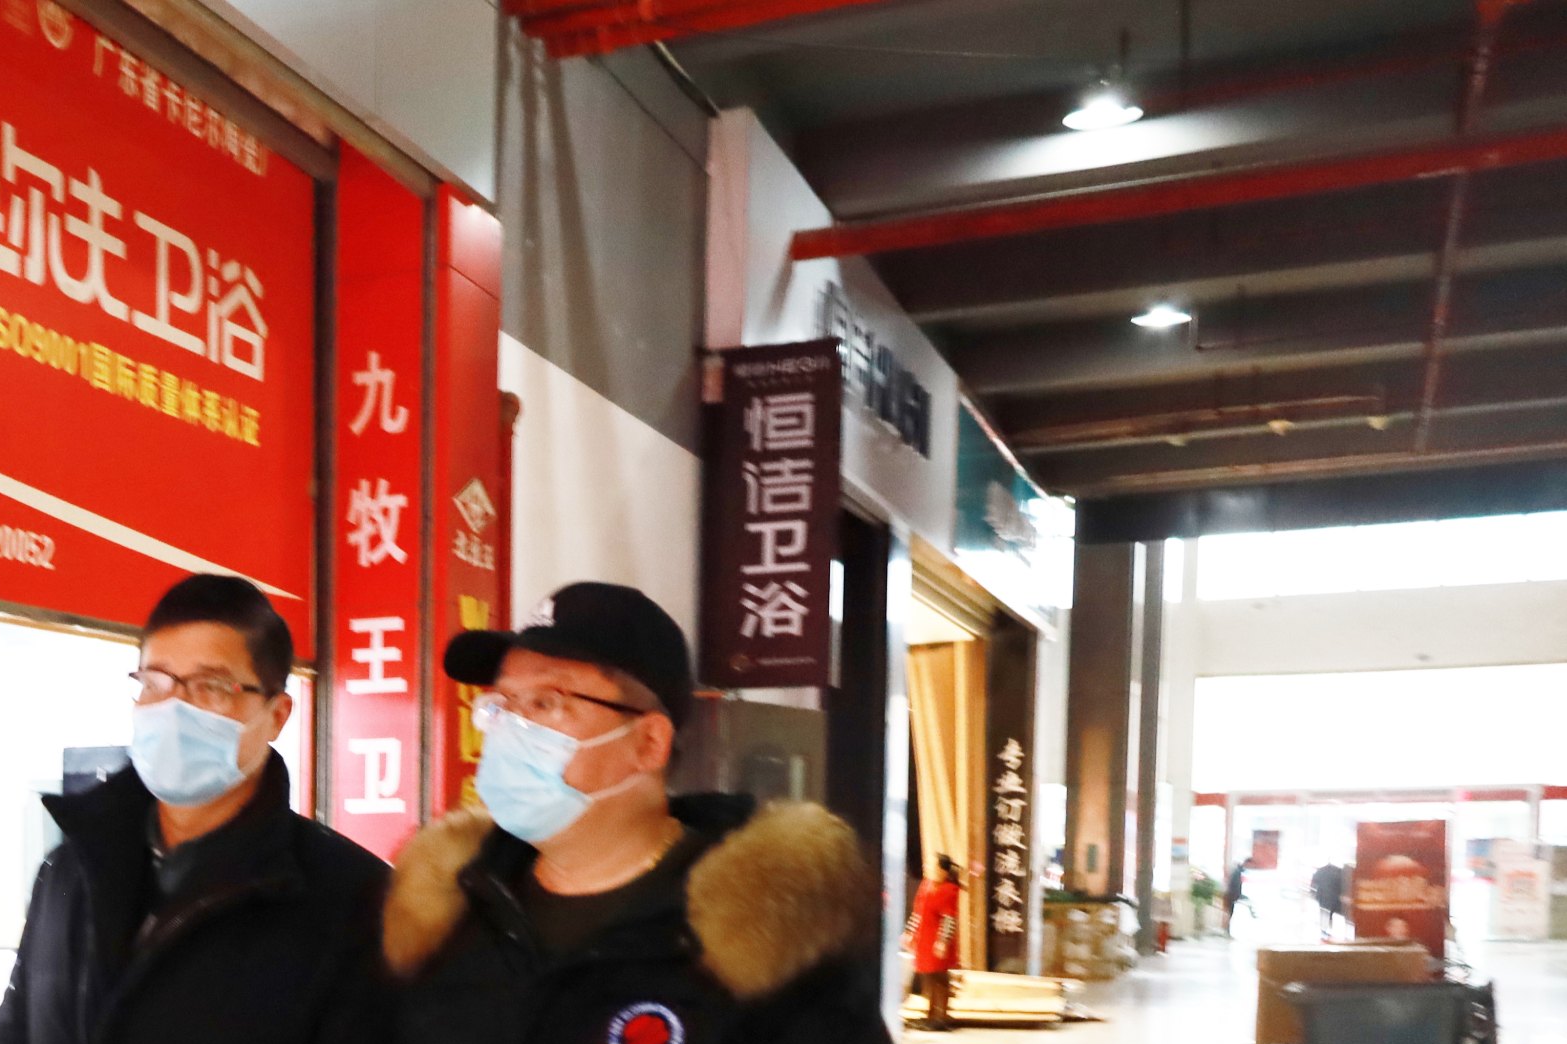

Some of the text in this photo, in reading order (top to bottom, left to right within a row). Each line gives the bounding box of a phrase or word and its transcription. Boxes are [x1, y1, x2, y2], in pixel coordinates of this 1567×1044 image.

[343, 350, 410, 815] 九牧王卫
[739, 391, 816, 639] 恒洁卫浴
